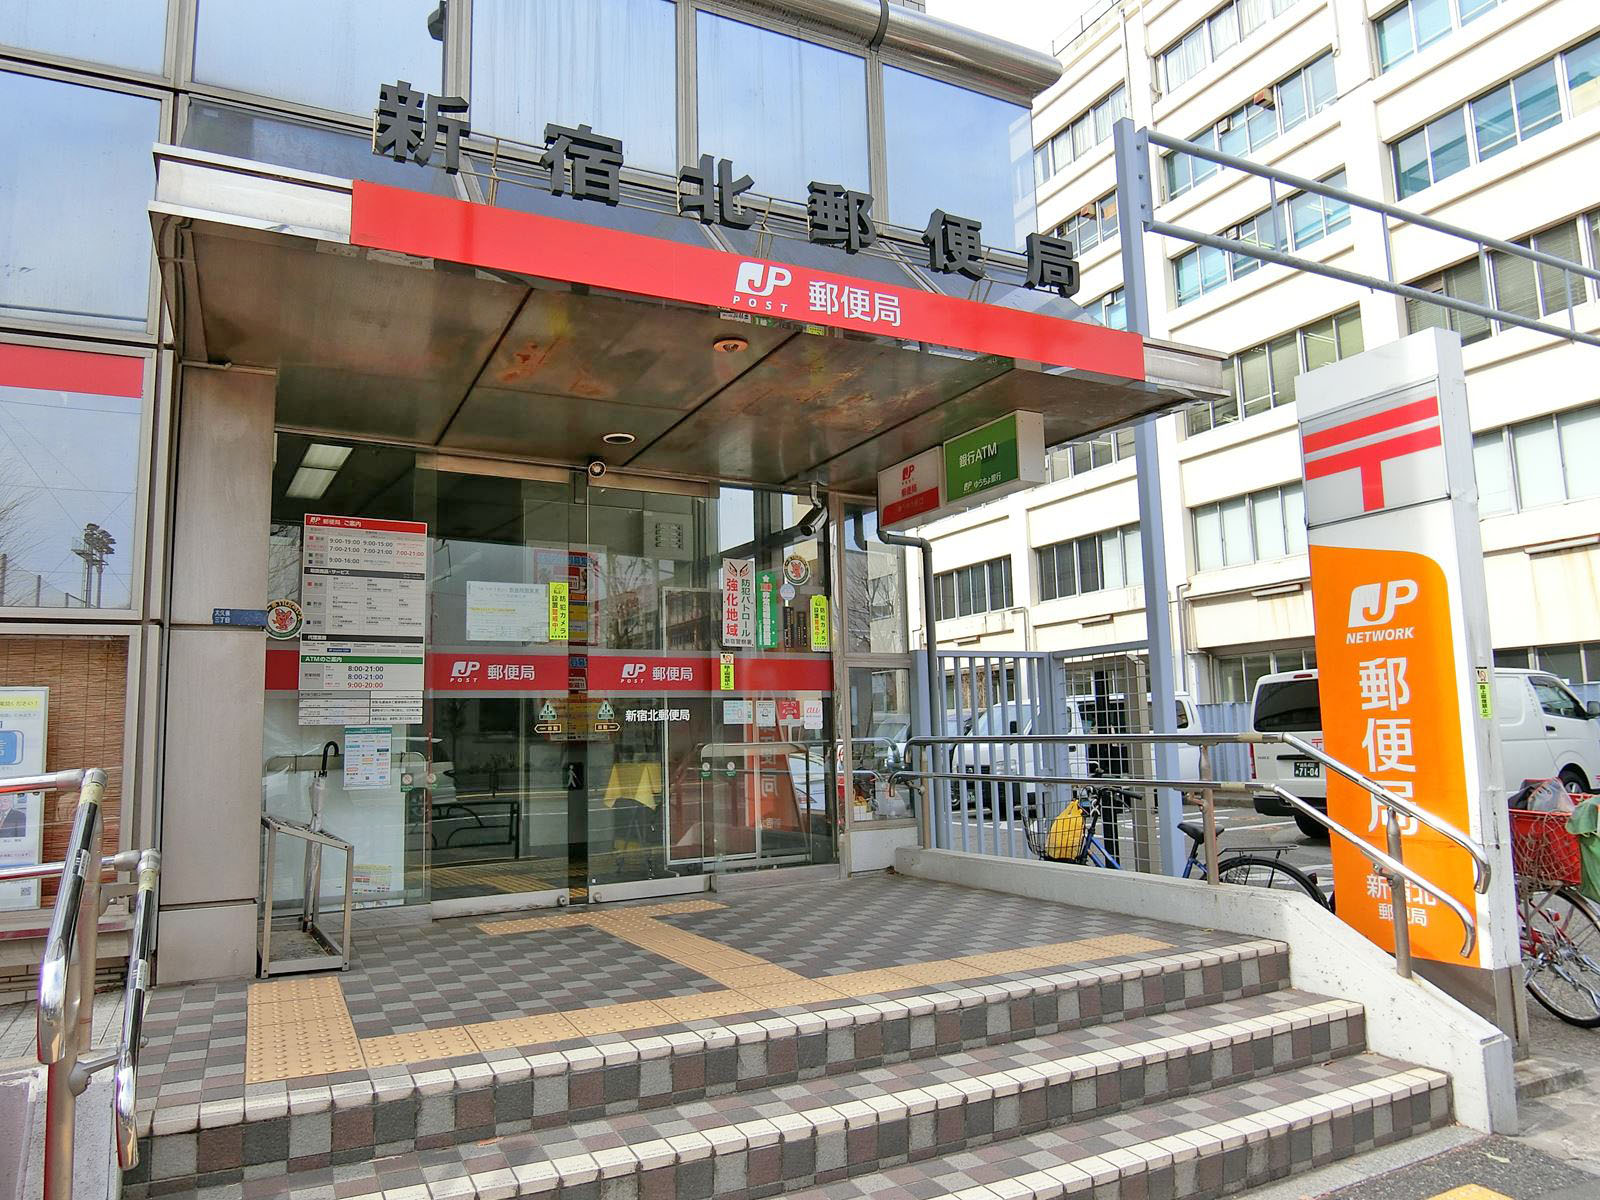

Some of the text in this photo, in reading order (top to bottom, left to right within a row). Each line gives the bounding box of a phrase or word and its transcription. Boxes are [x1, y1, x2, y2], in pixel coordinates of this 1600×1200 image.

[374, 81, 1080, 299] 新宿北郵便局
[735, 261, 791, 296] JP
[733, 296, 787, 313] POST
[808, 281, 901, 327] 郵便局
[959, 442, 997, 468] 銀行ATM
[973, 472, 1001, 488] ゆうちょ銀行
[726, 577, 738, 637] 強化地域
[741, 578, 751, 638] 防犯パトロール
[1347, 579, 1418, 628] JP
[214, 609, 231, 617] 大久保
[1345, 626, 1415, 644] NETWORK
[451, 661, 480, 677] JP
[487, 664, 535, 681] 郵便局
[621, 663, 647, 678] JP
[652, 666, 693, 682] 郵便局
[625, 709, 690, 722] 新宿北郵便局
[1378, 903, 1428, 927] 郵局
